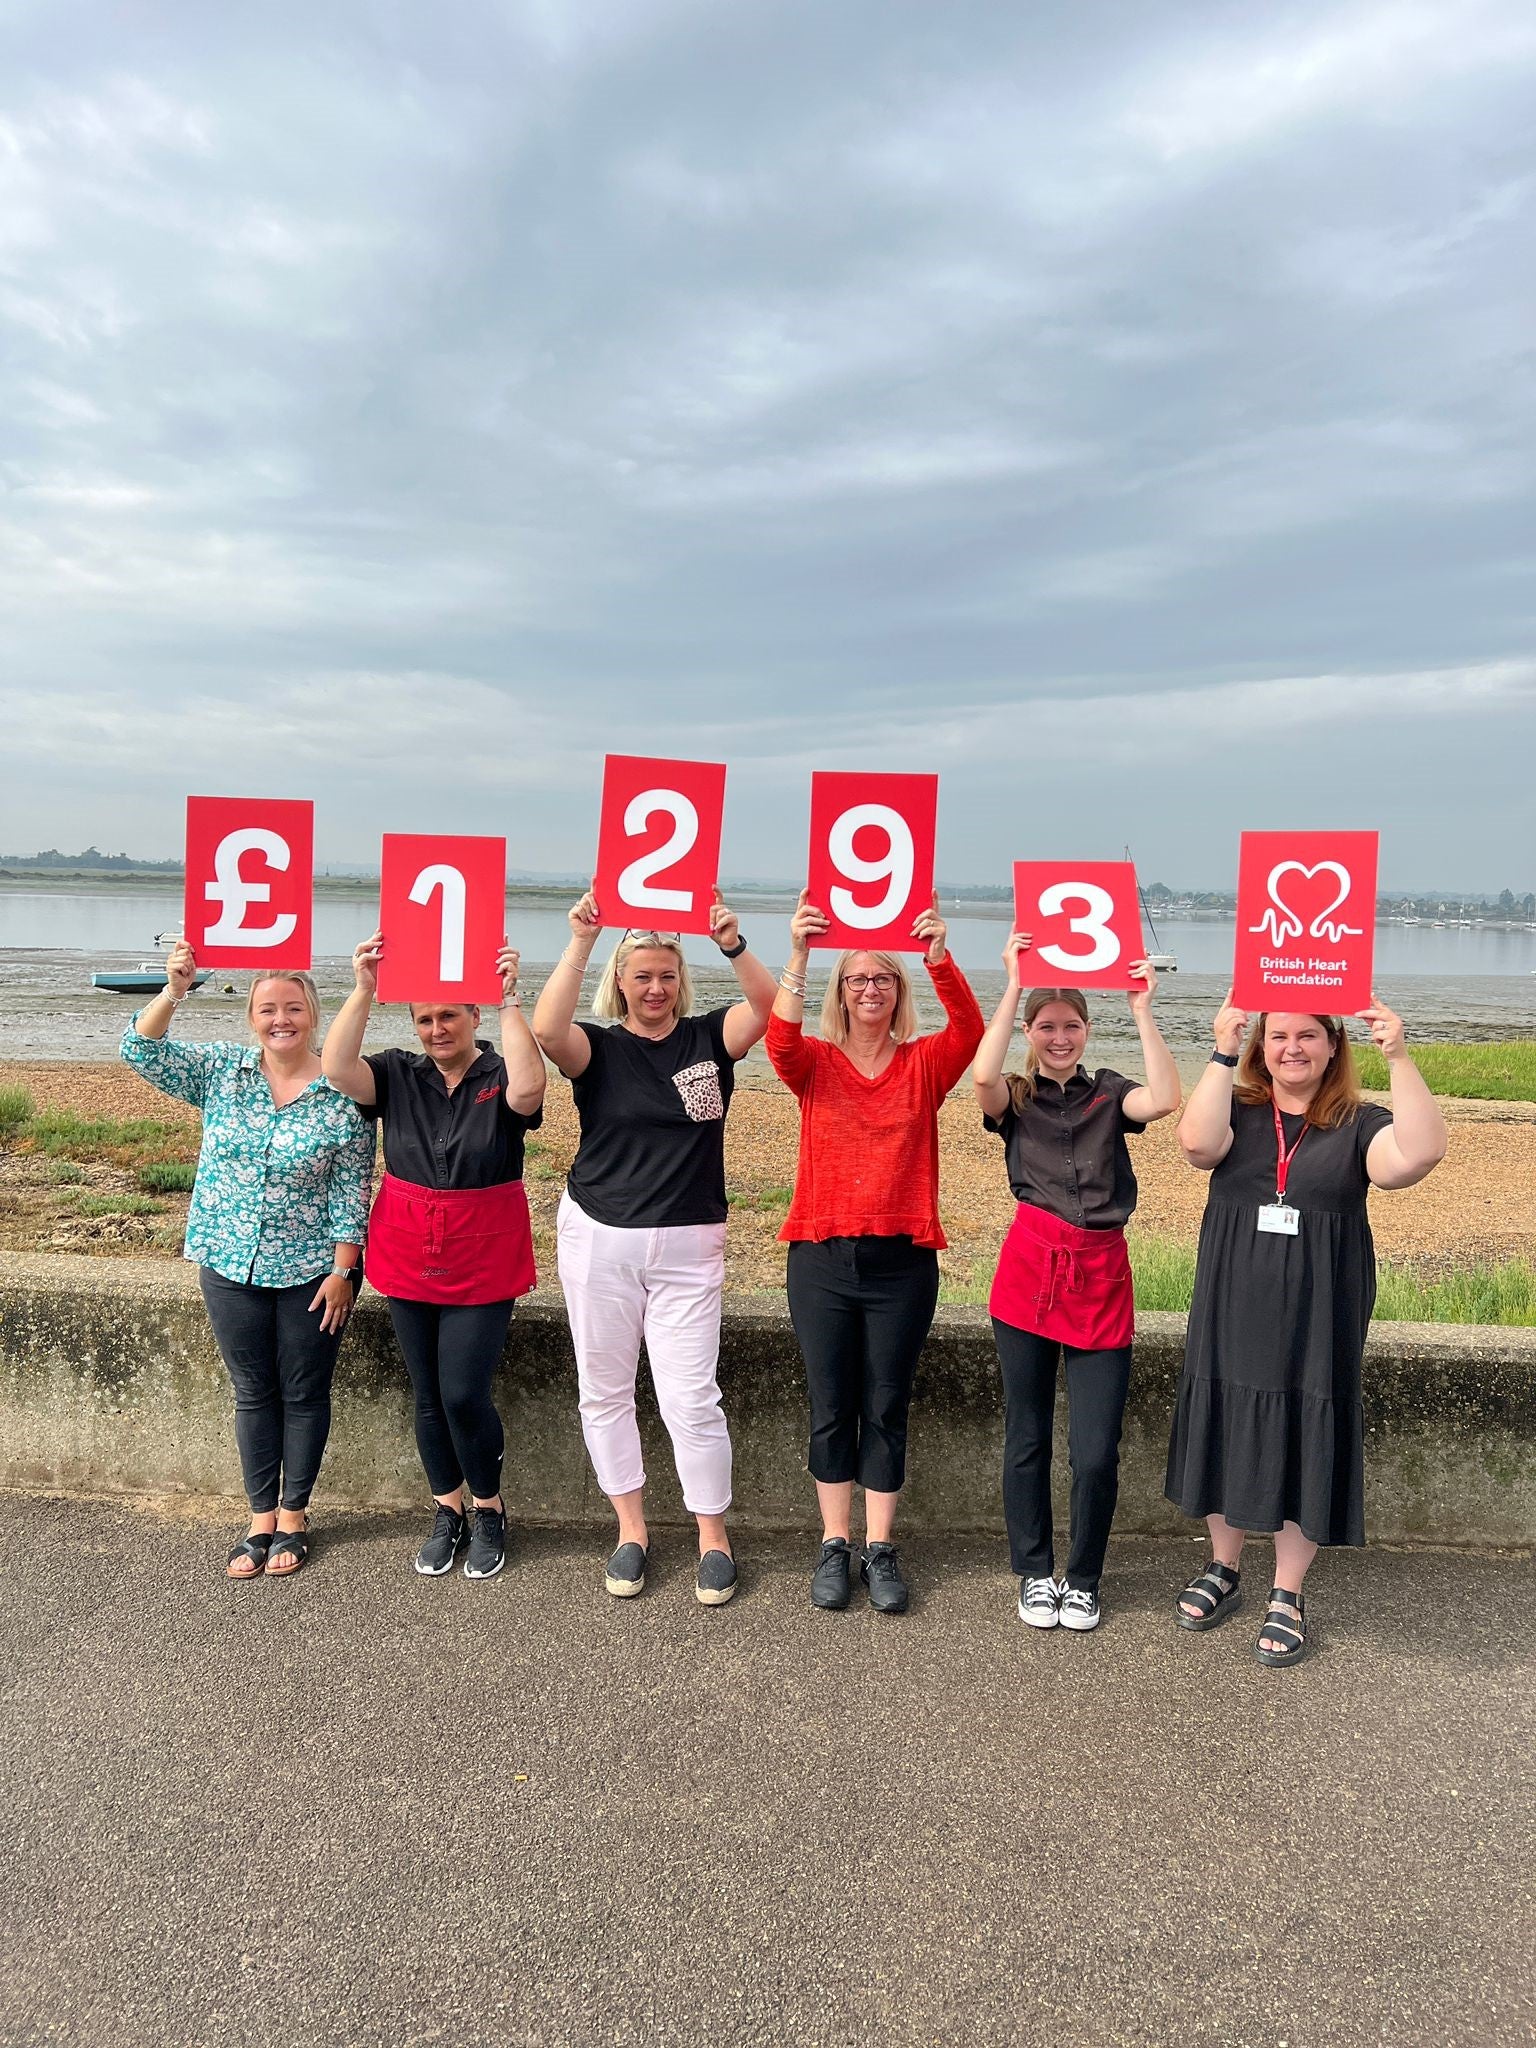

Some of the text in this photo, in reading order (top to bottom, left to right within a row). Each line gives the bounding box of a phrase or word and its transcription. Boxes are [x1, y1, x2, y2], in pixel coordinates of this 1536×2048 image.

[203, 827, 298, 948] £
[617, 788, 699, 912] 2
[828, 803, 915, 930] 9
[407, 863, 467, 982] 1
[1036, 881, 1121, 973] 3
[1259, 956, 1348, 971] British Heart
[1263, 971, 1343, 986] Foundation
